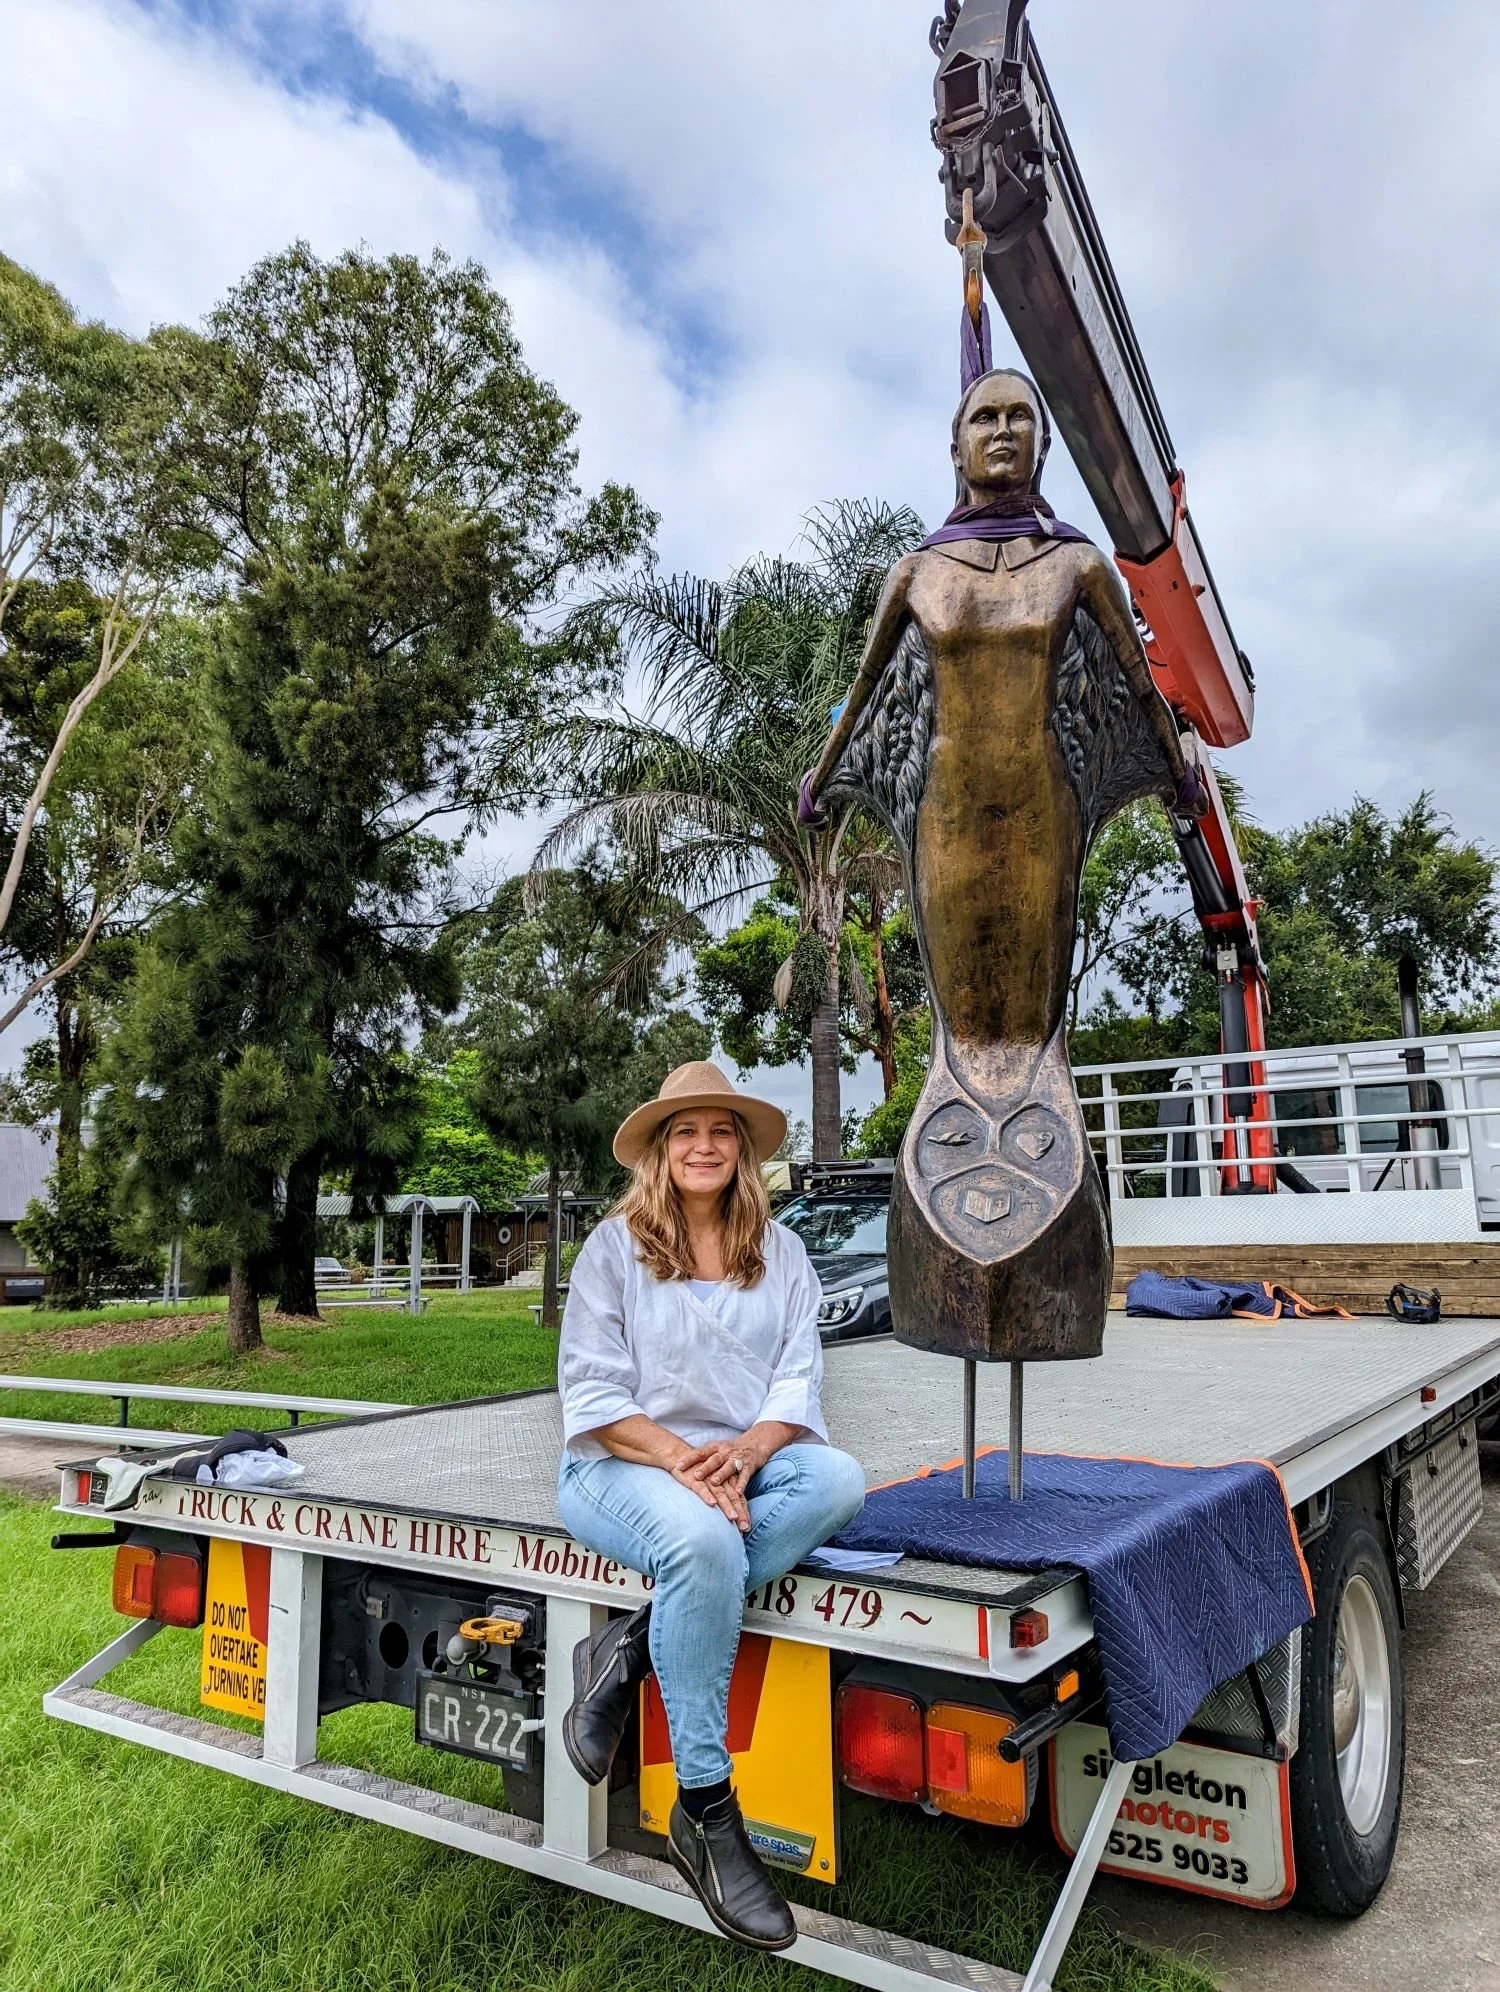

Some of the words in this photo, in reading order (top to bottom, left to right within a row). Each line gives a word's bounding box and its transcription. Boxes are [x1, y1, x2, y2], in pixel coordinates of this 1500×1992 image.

[177, 1488, 259, 1526] TRUCK
[267, 1500, 285, 1531] &
[294, 1504, 398, 1548] CRANE
[408, 1520, 492, 1564] HIRE
[814, 1583, 883, 1629] 479
[211, 1601, 225, 1628] DO
[228, 1604, 247, 1632] NOT
[210, 1633, 259, 1669] OVERTAKE
[208, 1665, 249, 1700] TURNING
[461, 1686, 486, 1701] NSW
[1083, 1749, 1247, 1810] sigleton
[1105, 1829, 1163, 1863] 525
[1172, 1843, 1249, 1885] 9033
